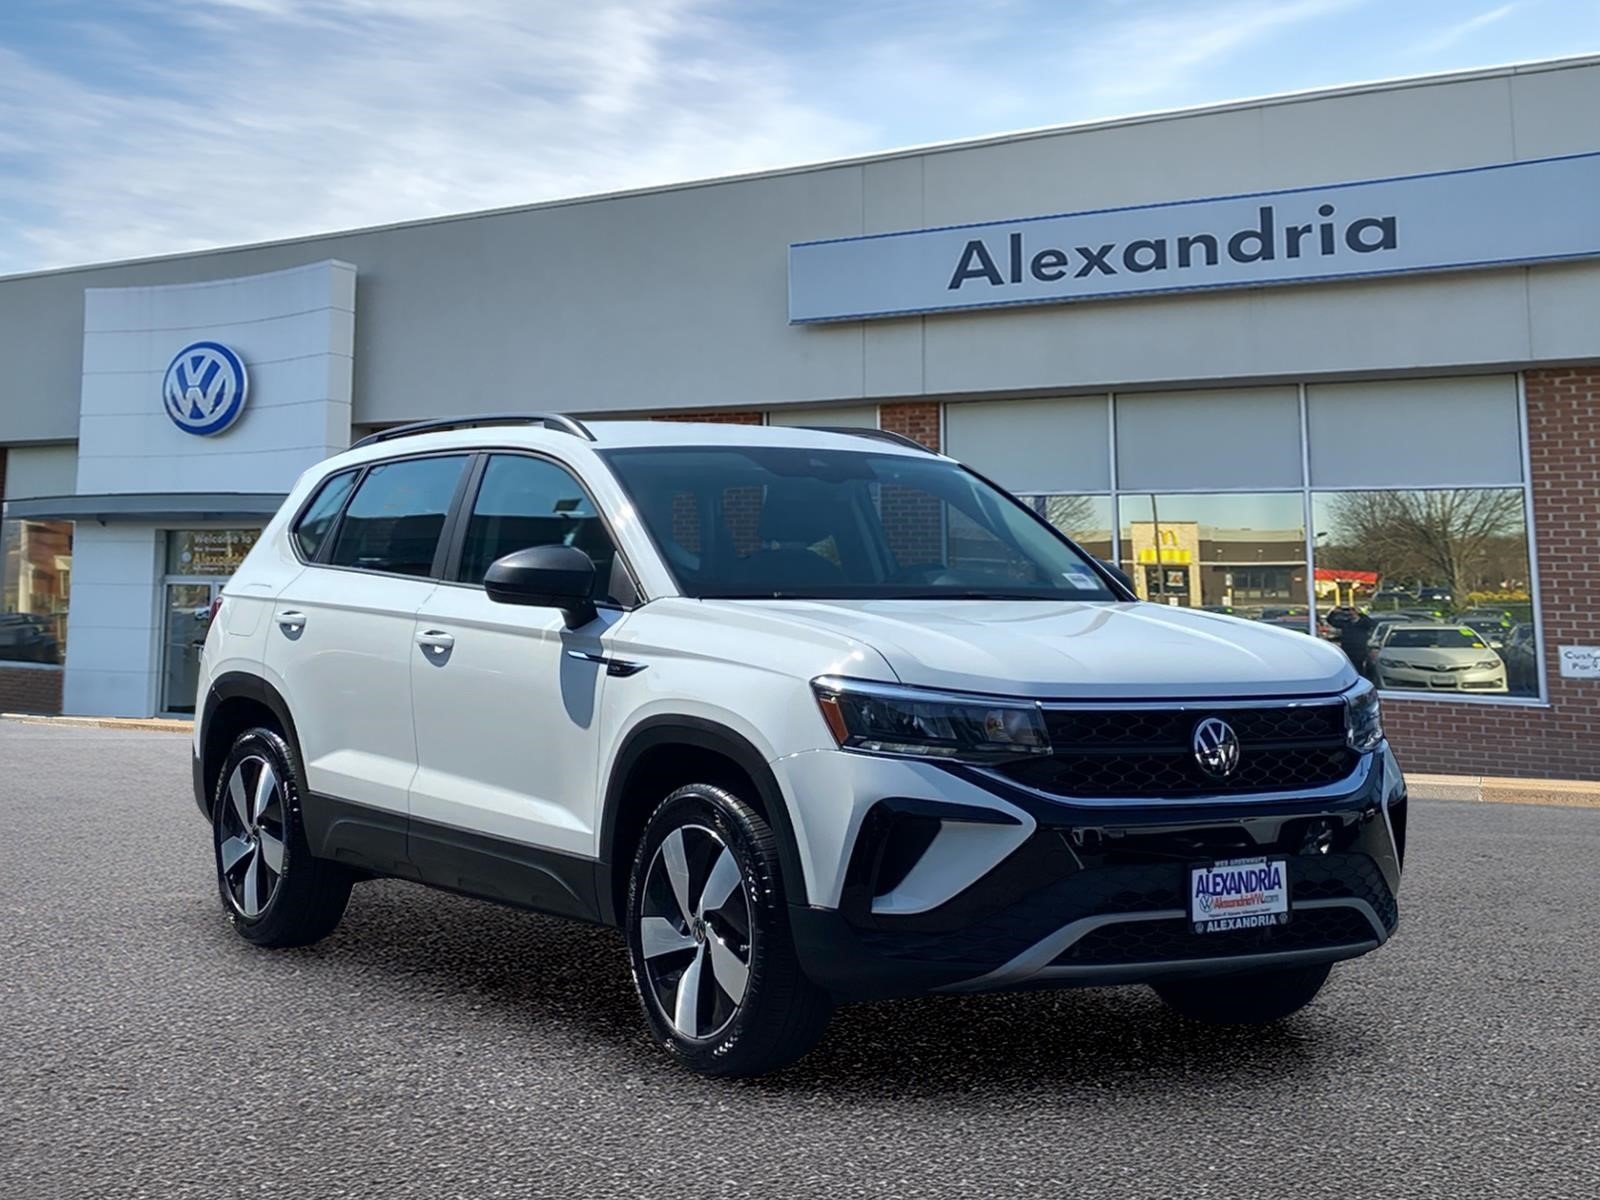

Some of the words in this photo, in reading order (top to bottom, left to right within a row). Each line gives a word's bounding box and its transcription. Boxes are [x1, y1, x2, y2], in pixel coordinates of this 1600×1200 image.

[948, 204, 1397, 289] Alexandria
[194, 533, 239, 544] Welcome
[1195, 867, 1282, 898] ALEXANDRIA
[1207, 914, 1277, 933] ALEXANDRIA
